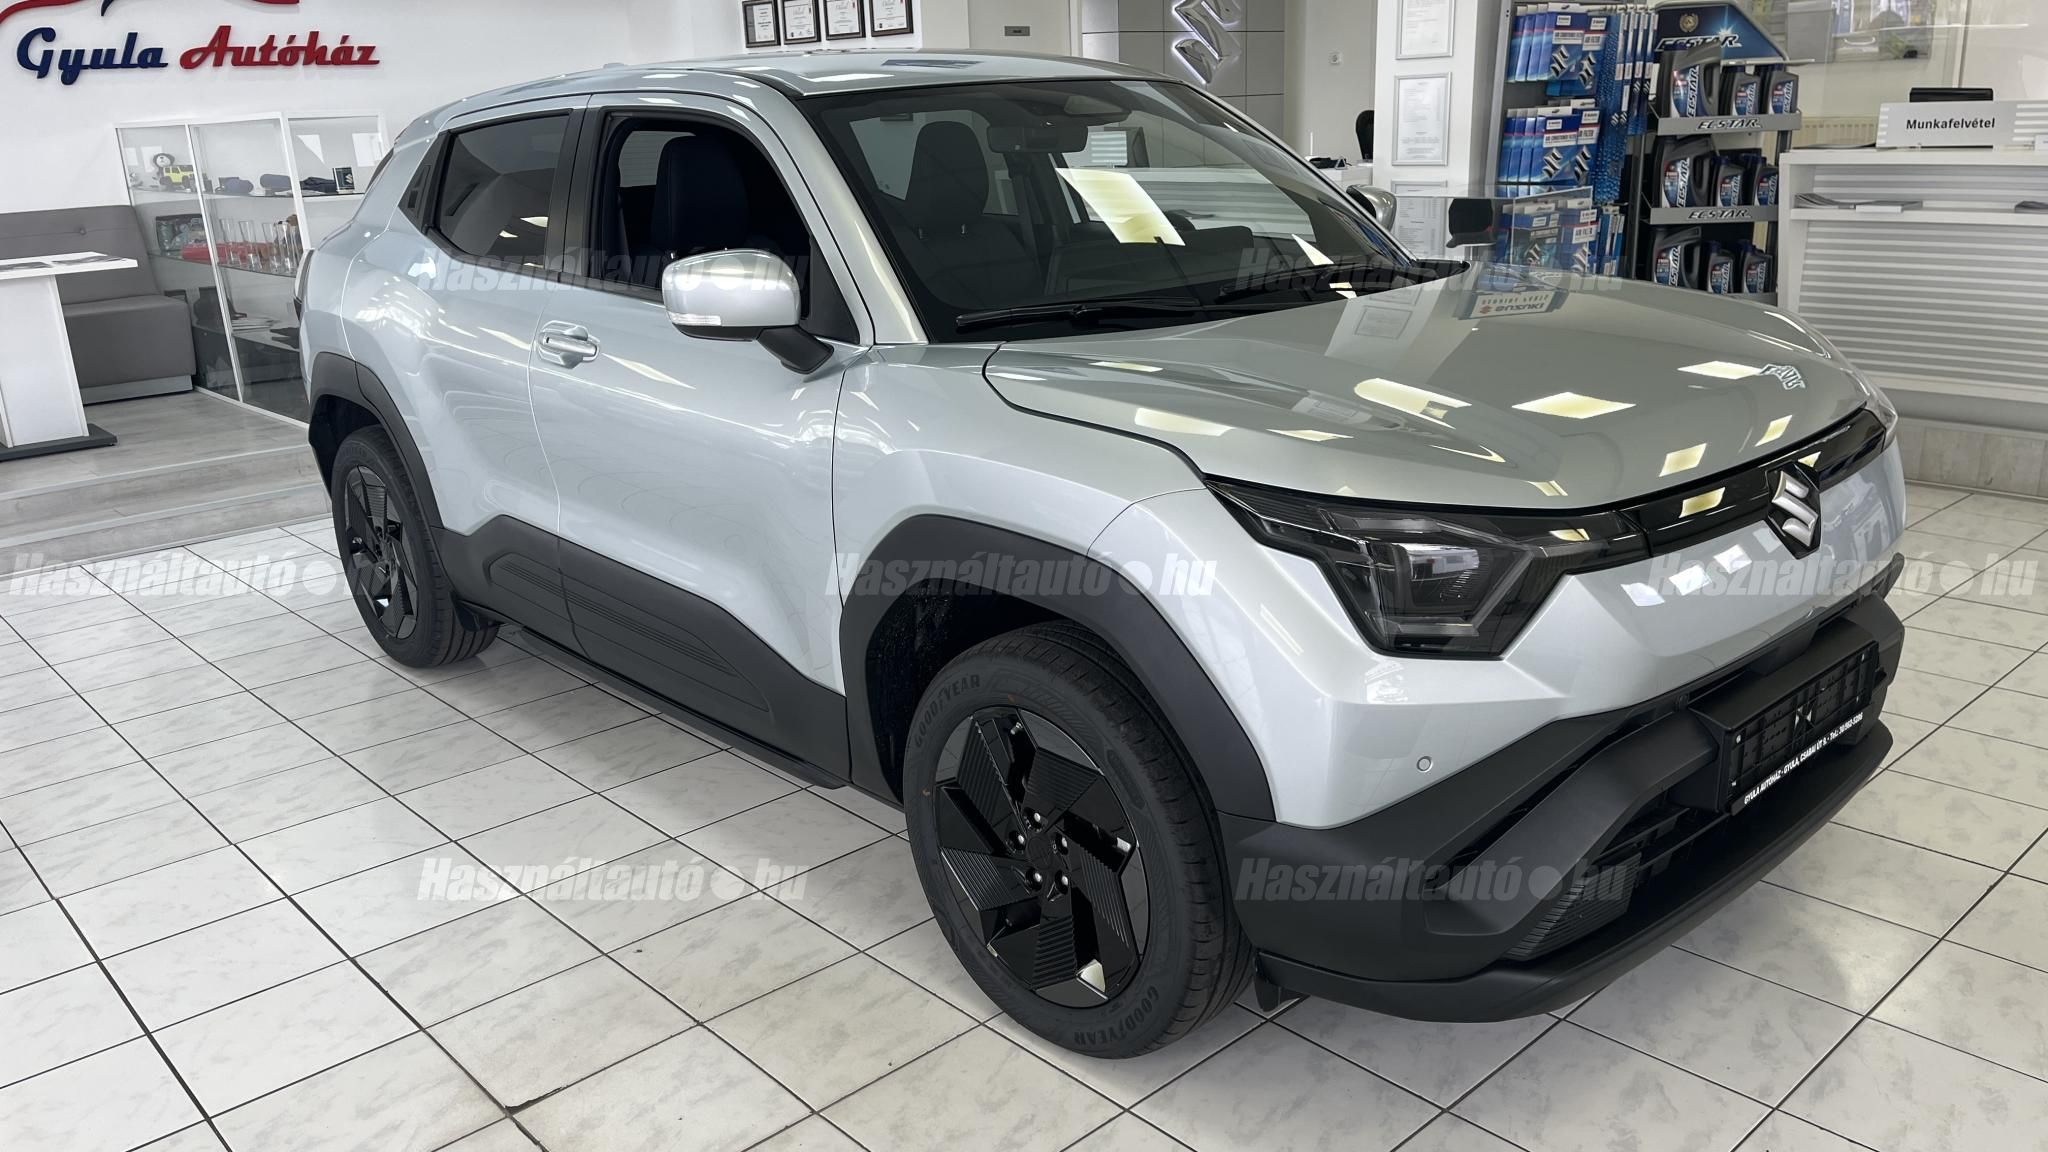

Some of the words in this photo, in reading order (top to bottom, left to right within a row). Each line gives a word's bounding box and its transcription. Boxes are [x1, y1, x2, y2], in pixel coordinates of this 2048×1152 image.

[16, 27, 168, 85] Gyula
[180, 25, 380, 69] Autóház
[1696, 118, 1762, 130] ECSTAR
[1906, 117, 1996, 129] Munkafelvétel
[1687, 209, 1752, 219] ECSTAR
[1669, 245, 1681, 287] CSTAR
